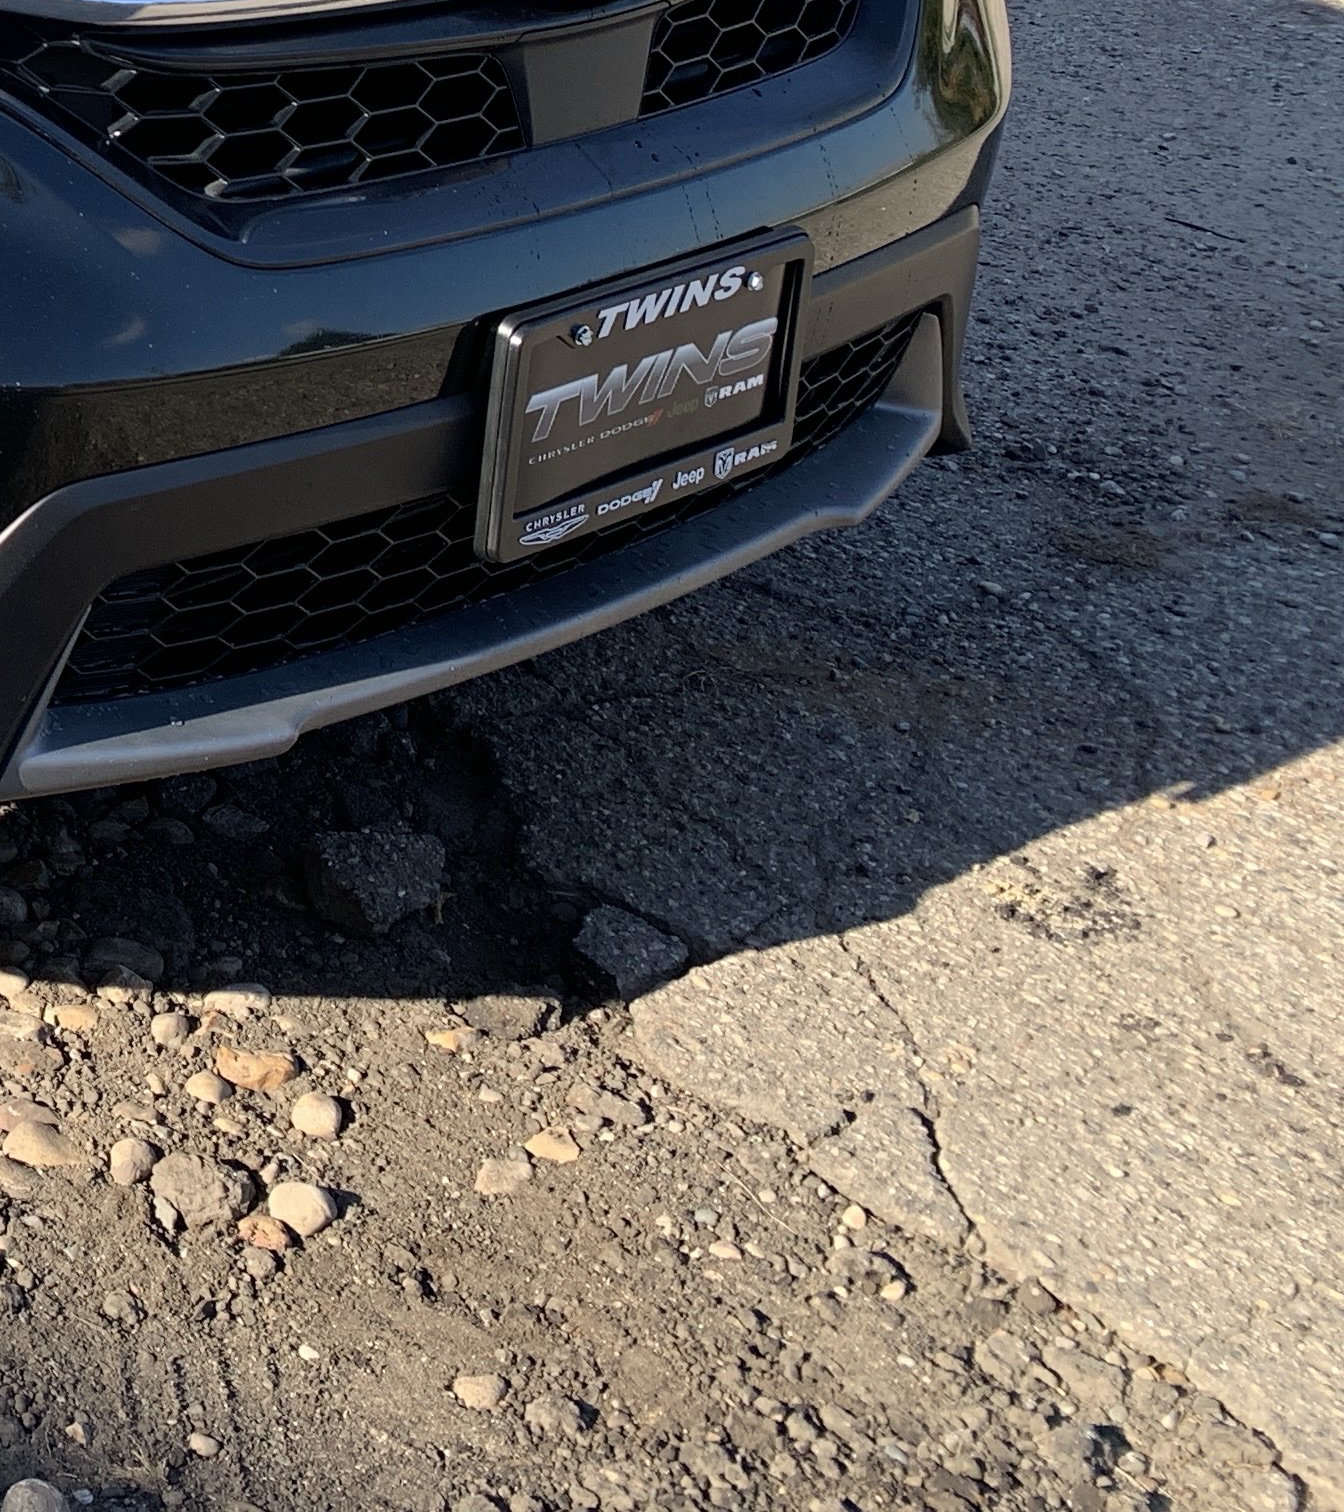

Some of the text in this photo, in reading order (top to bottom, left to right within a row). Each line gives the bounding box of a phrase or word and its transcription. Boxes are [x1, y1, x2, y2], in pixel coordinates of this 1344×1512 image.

[597, 266, 746, 339] TWINS
[525, 317, 778, 442] TWINS
[528, 436, 595, 465] CHRYSLER
[718, 374, 764, 400] RAM
[525, 440, 778, 532] CHRYSLER DODGE Jeep RAM
